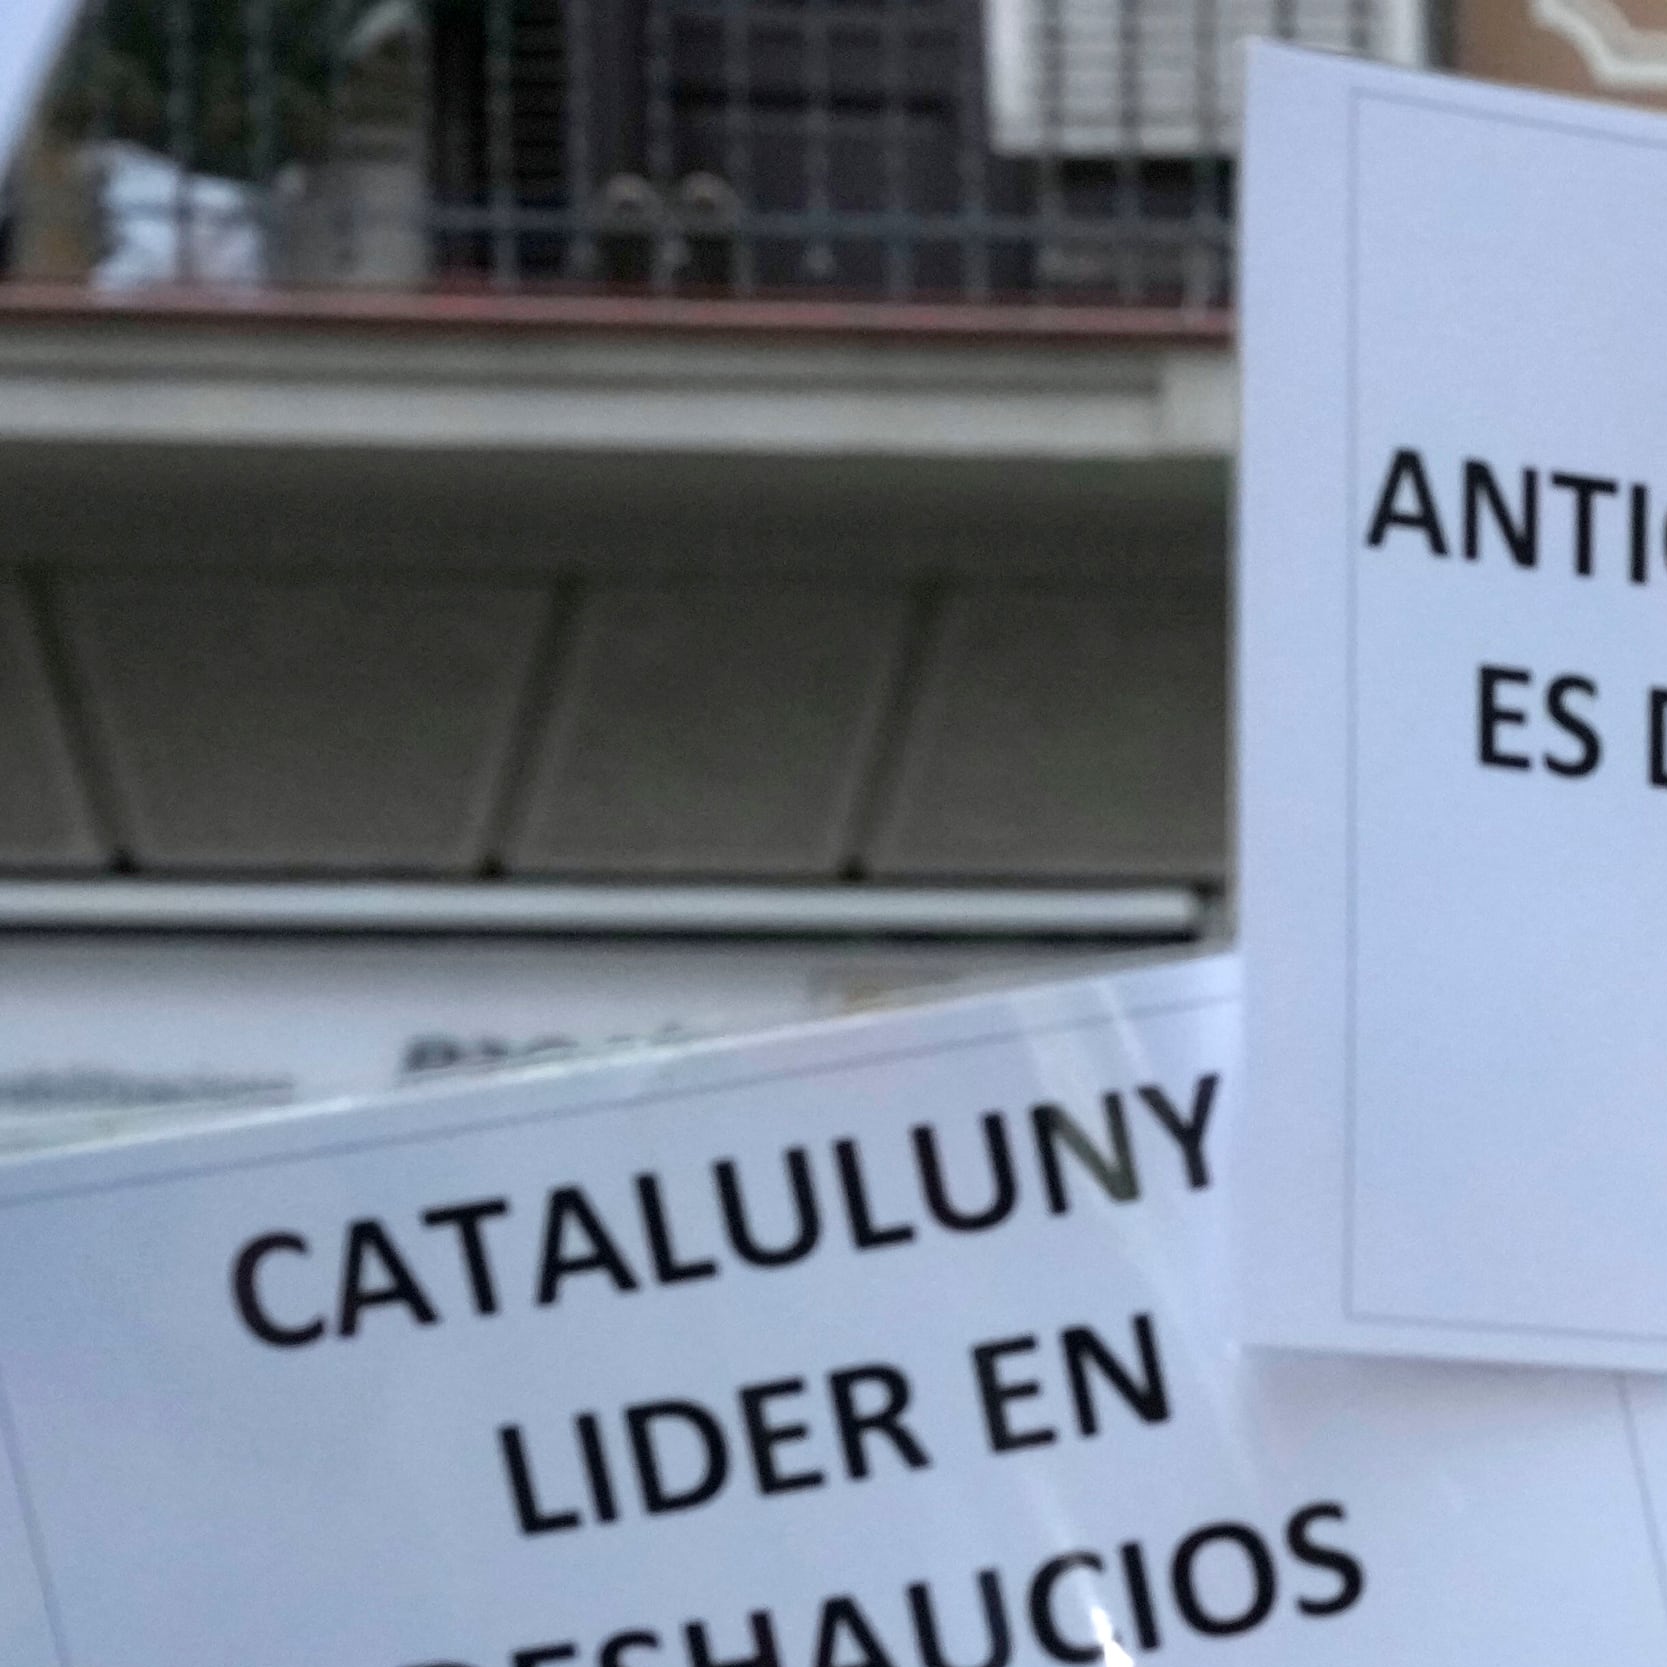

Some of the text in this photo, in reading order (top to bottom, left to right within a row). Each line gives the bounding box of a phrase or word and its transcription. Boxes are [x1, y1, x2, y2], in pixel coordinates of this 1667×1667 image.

[1478, 665, 1602, 781] ES
[231, 1072, 1221, 1350] CATALULUNY
[498, 1313, 1170, 1537] LIDER EN
